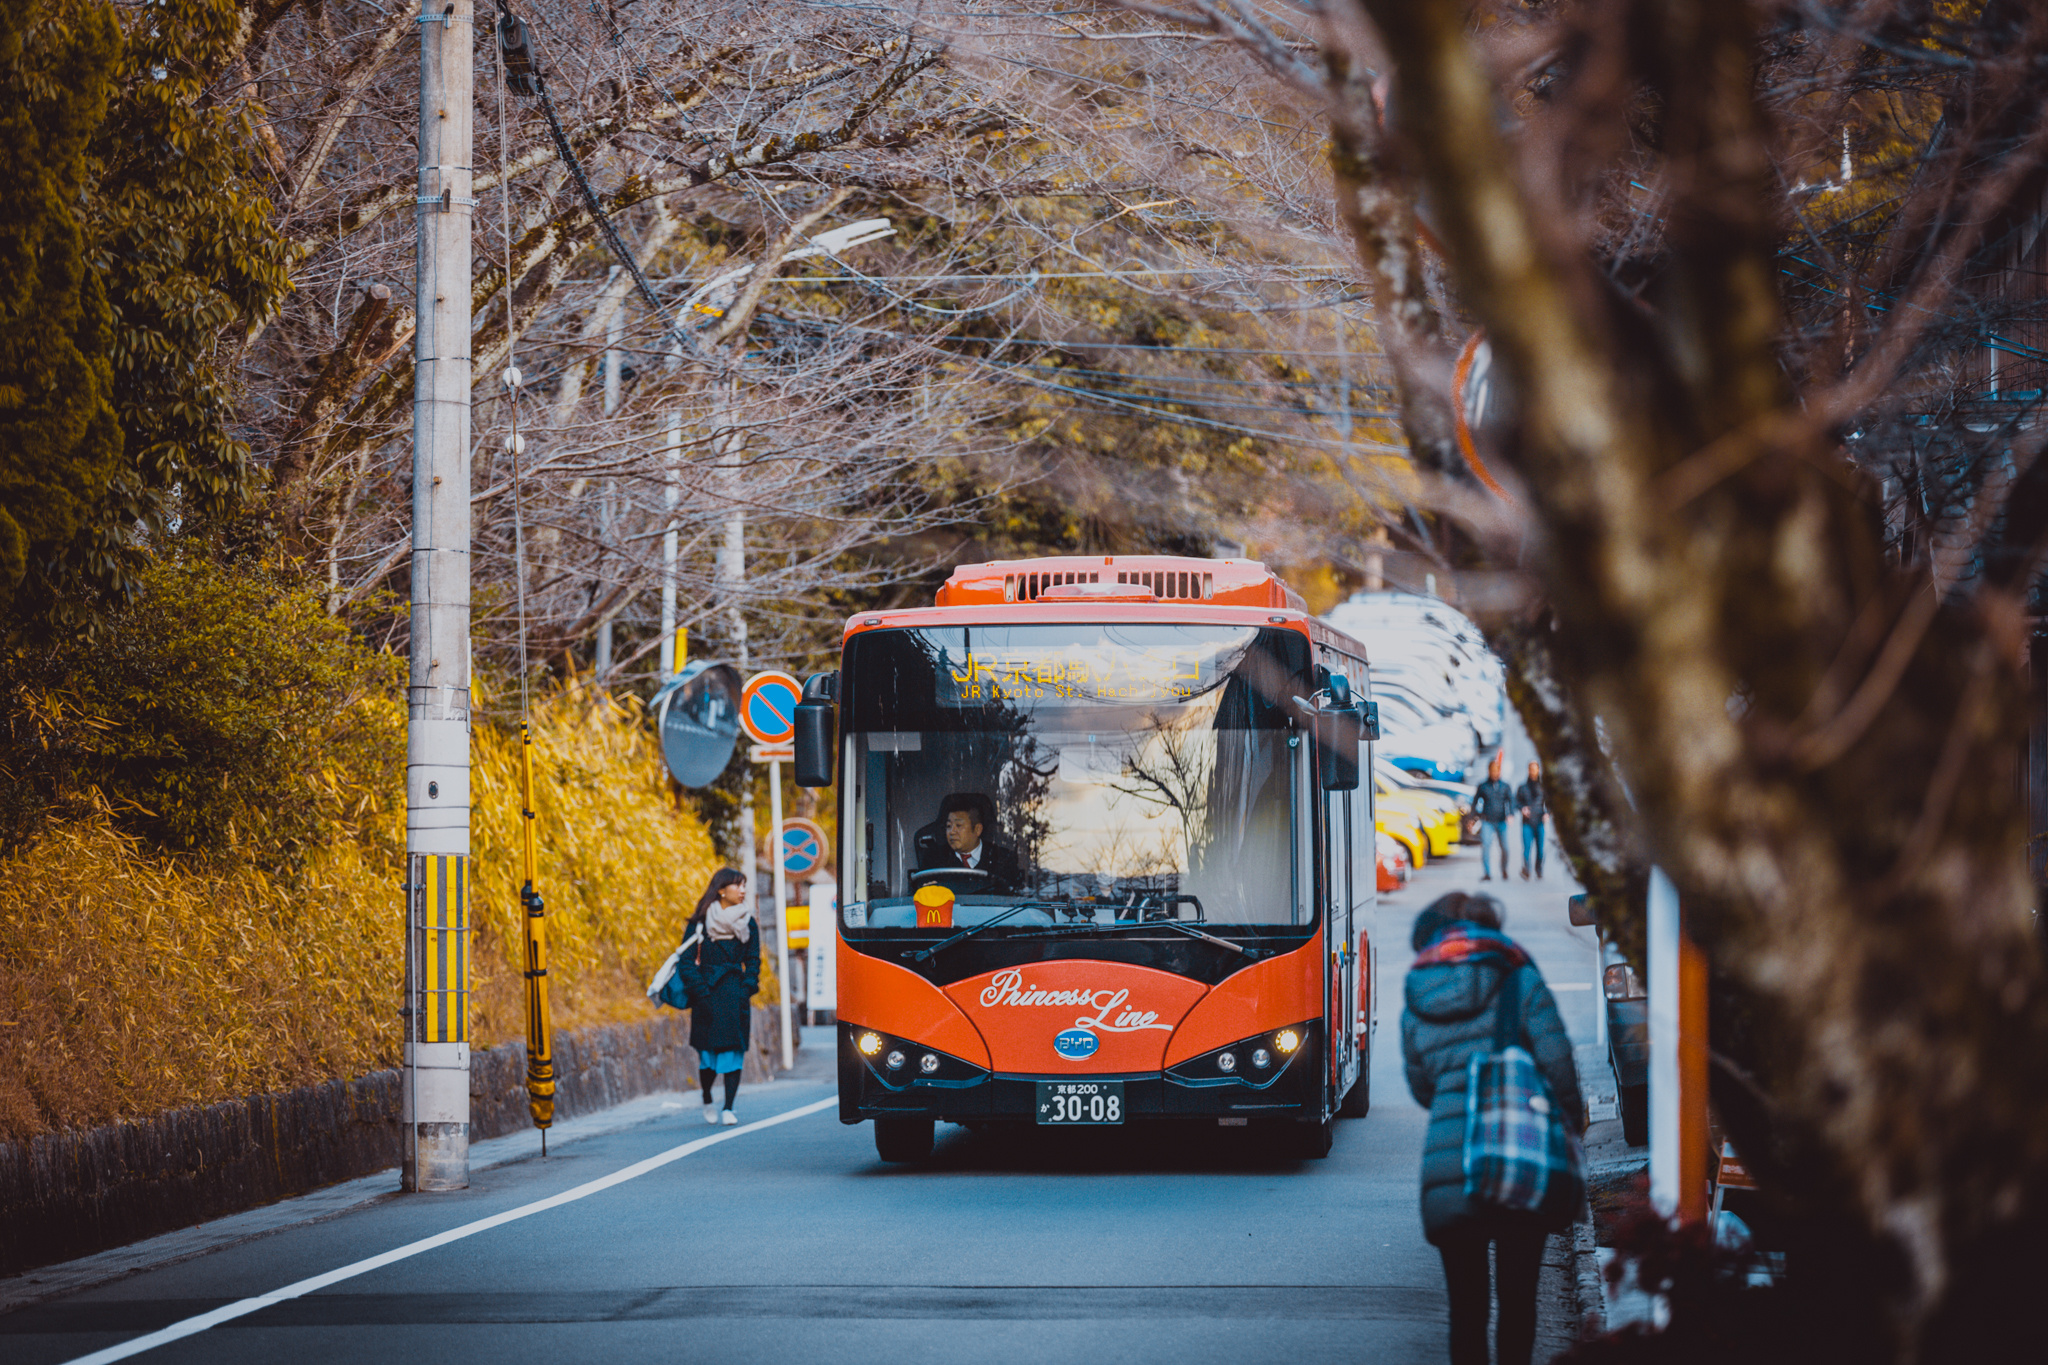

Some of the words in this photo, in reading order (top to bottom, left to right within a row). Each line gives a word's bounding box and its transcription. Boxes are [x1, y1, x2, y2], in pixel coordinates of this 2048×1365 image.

[961, 685, 981, 698] JR
[992, 685, 1044, 699] Kyoto
[1055, 684, 1082, 698] St.
[979, 968, 1091, 1007] Princess
[1075, 988, 1173, 1032] Line
[1059, 1037, 1093, 1050] BYD
[1057, 1084, 1098, 1094] 京都200
[1052, 1095, 1120, 1121] 30-08
